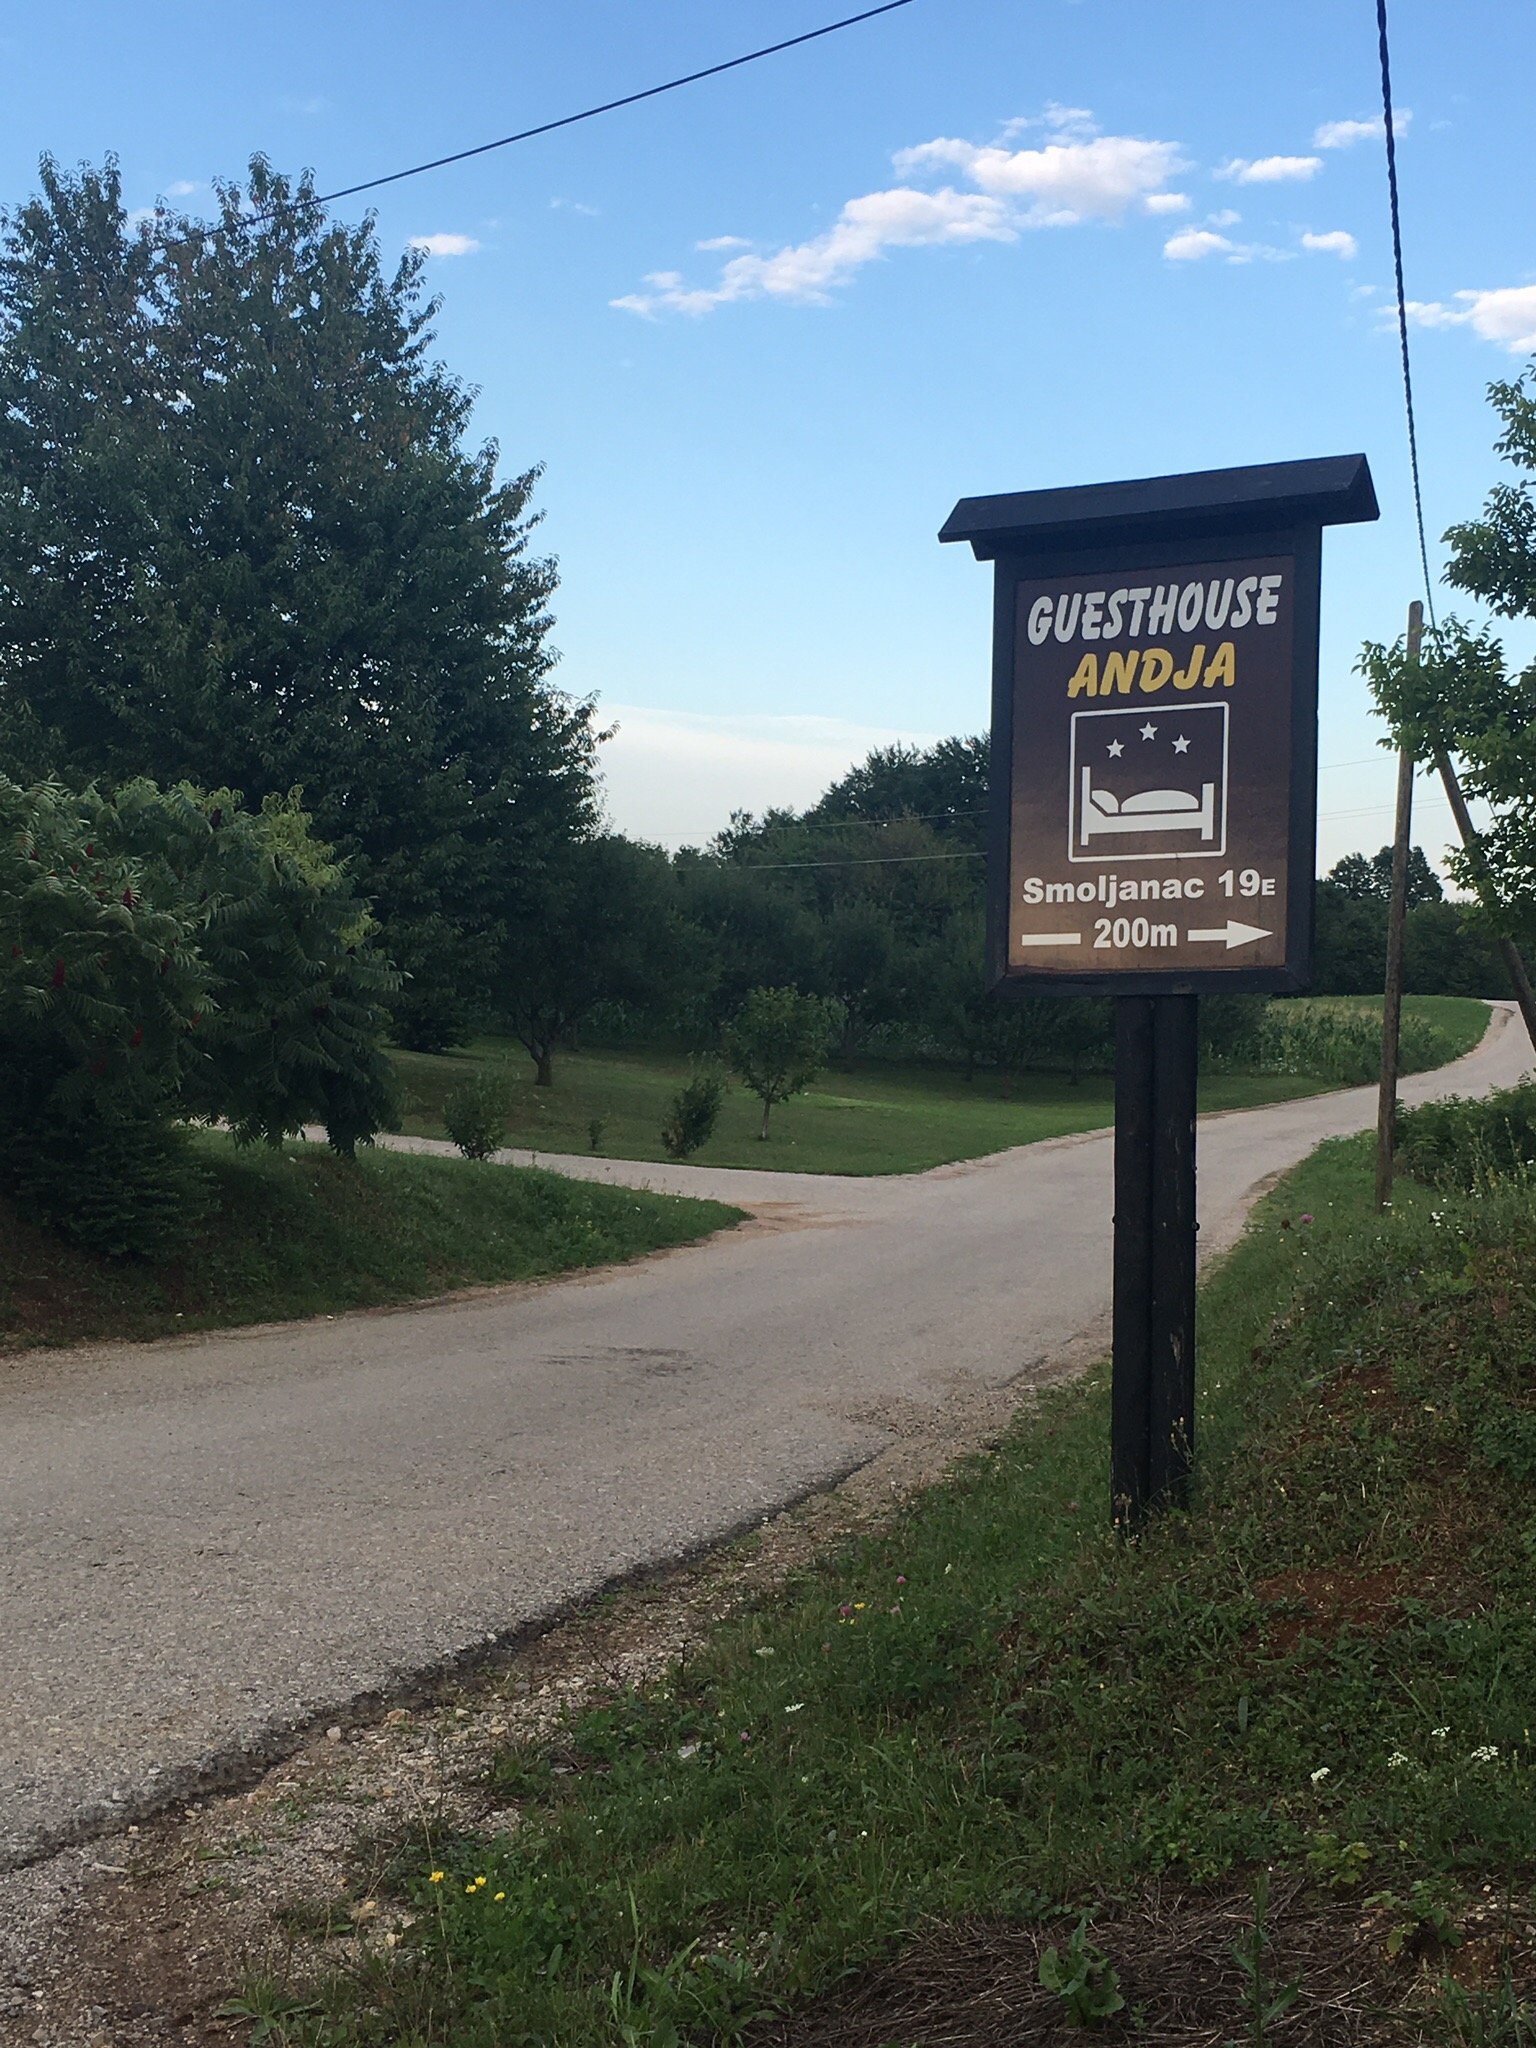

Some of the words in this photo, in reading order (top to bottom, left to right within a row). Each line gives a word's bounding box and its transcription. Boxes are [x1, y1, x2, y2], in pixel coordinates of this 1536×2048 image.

[1027, 574, 1282, 646] GUESTHOUSE
[1066, 641, 1235, 698] ANDJA
[1022, 874, 1205, 908] Smoljanac
[1217, 868, 1276, 898] 19E
[1093, 917, 1178, 949] 200m
